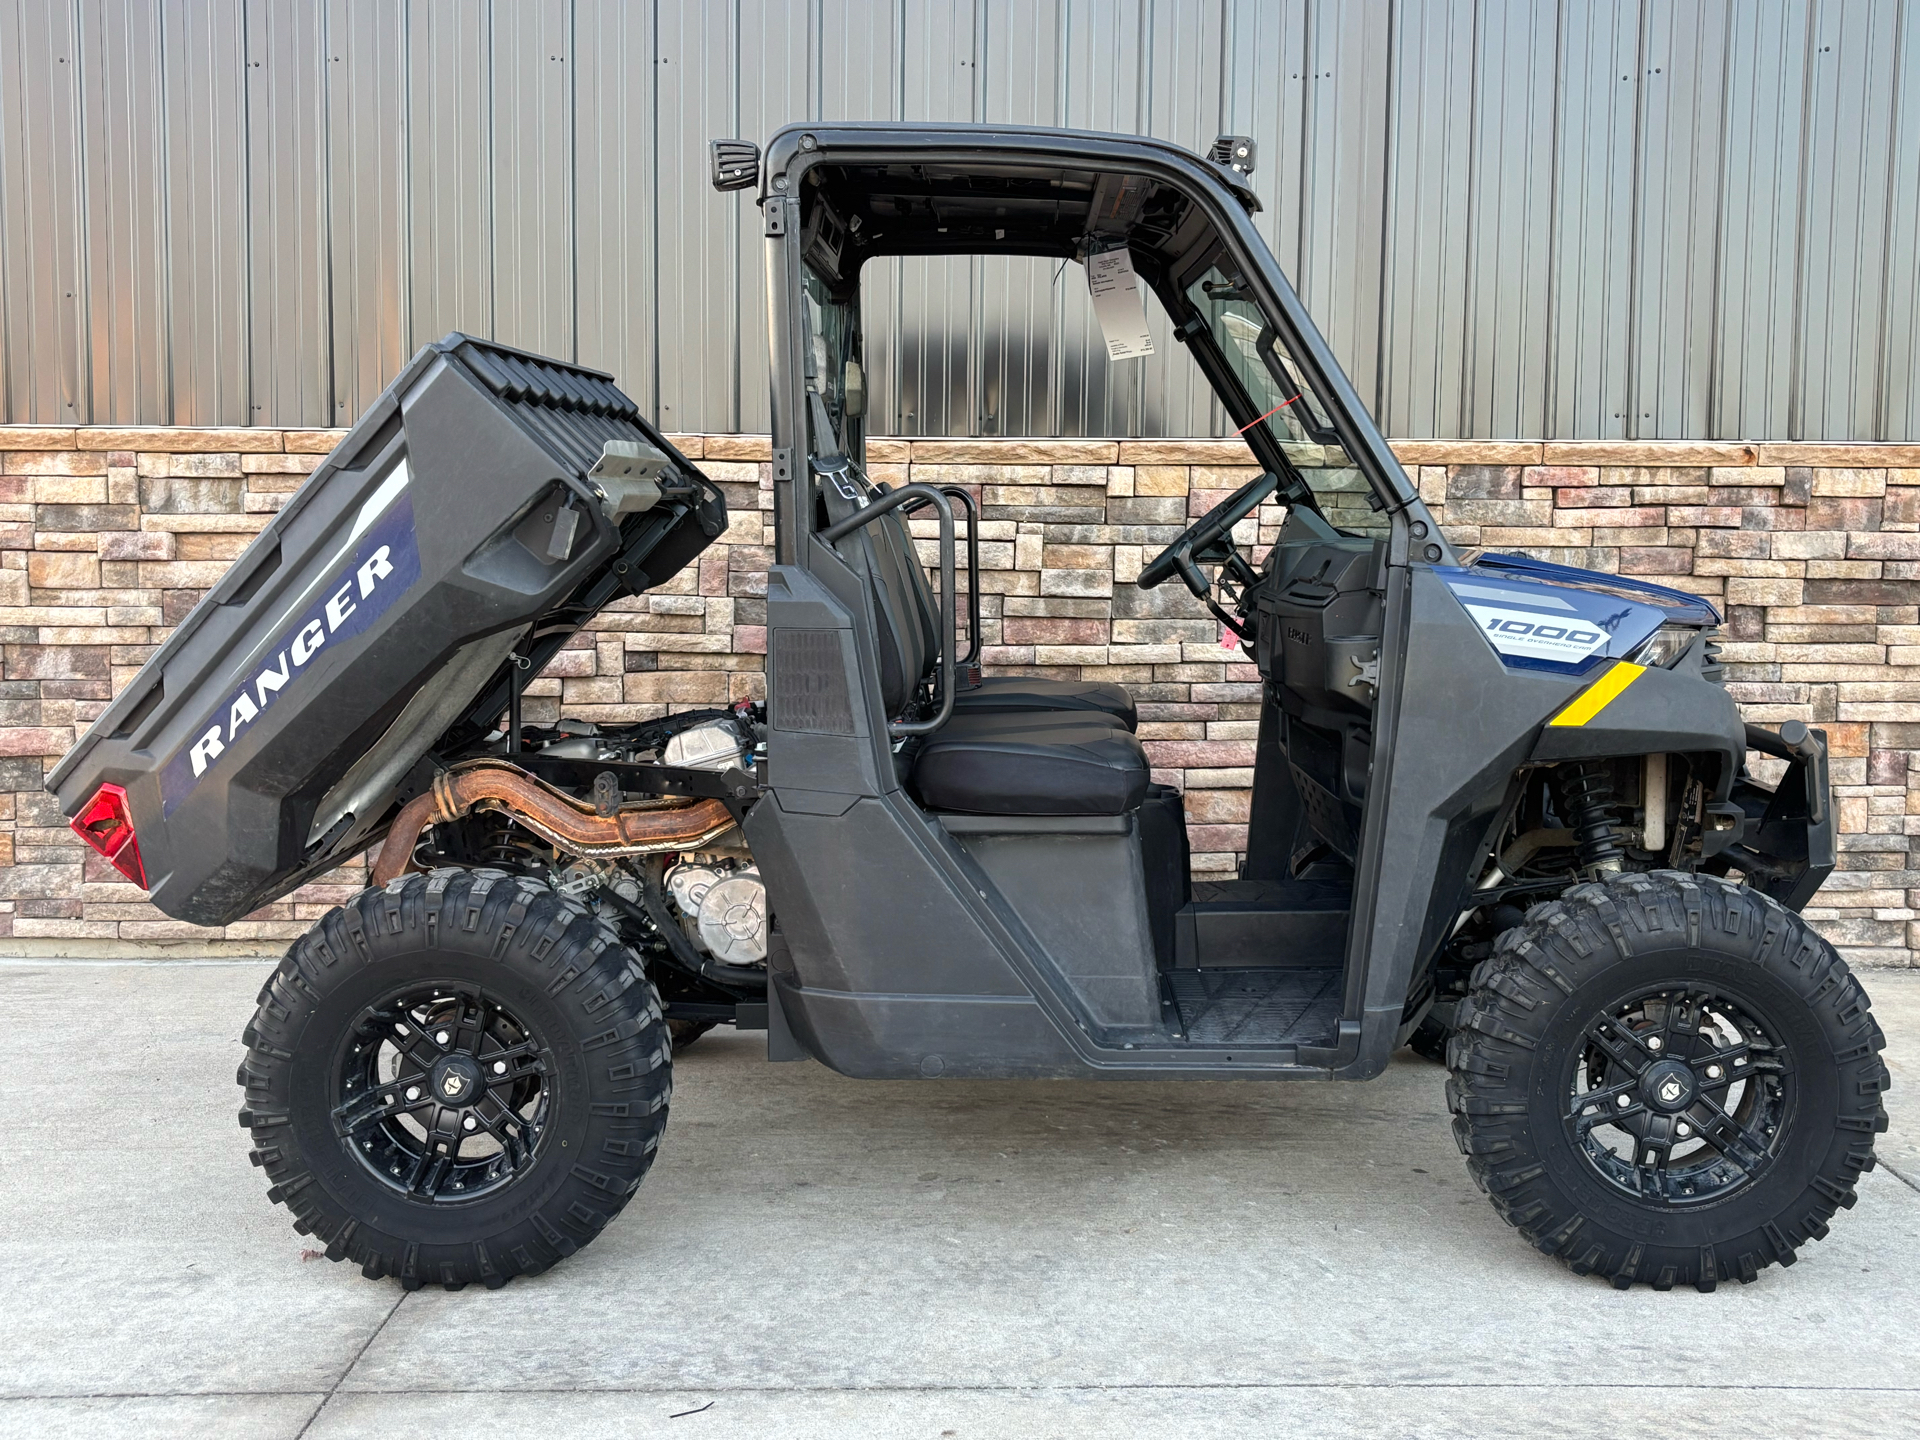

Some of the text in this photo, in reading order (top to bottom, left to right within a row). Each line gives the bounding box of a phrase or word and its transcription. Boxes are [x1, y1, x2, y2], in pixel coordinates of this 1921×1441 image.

[1486, 618, 1600, 644] 1000
[1493, 633, 1525, 642] SINGLE
[1527, 639, 1572, 649] OVERHEAD
[189, 545, 394, 778] RANGER
